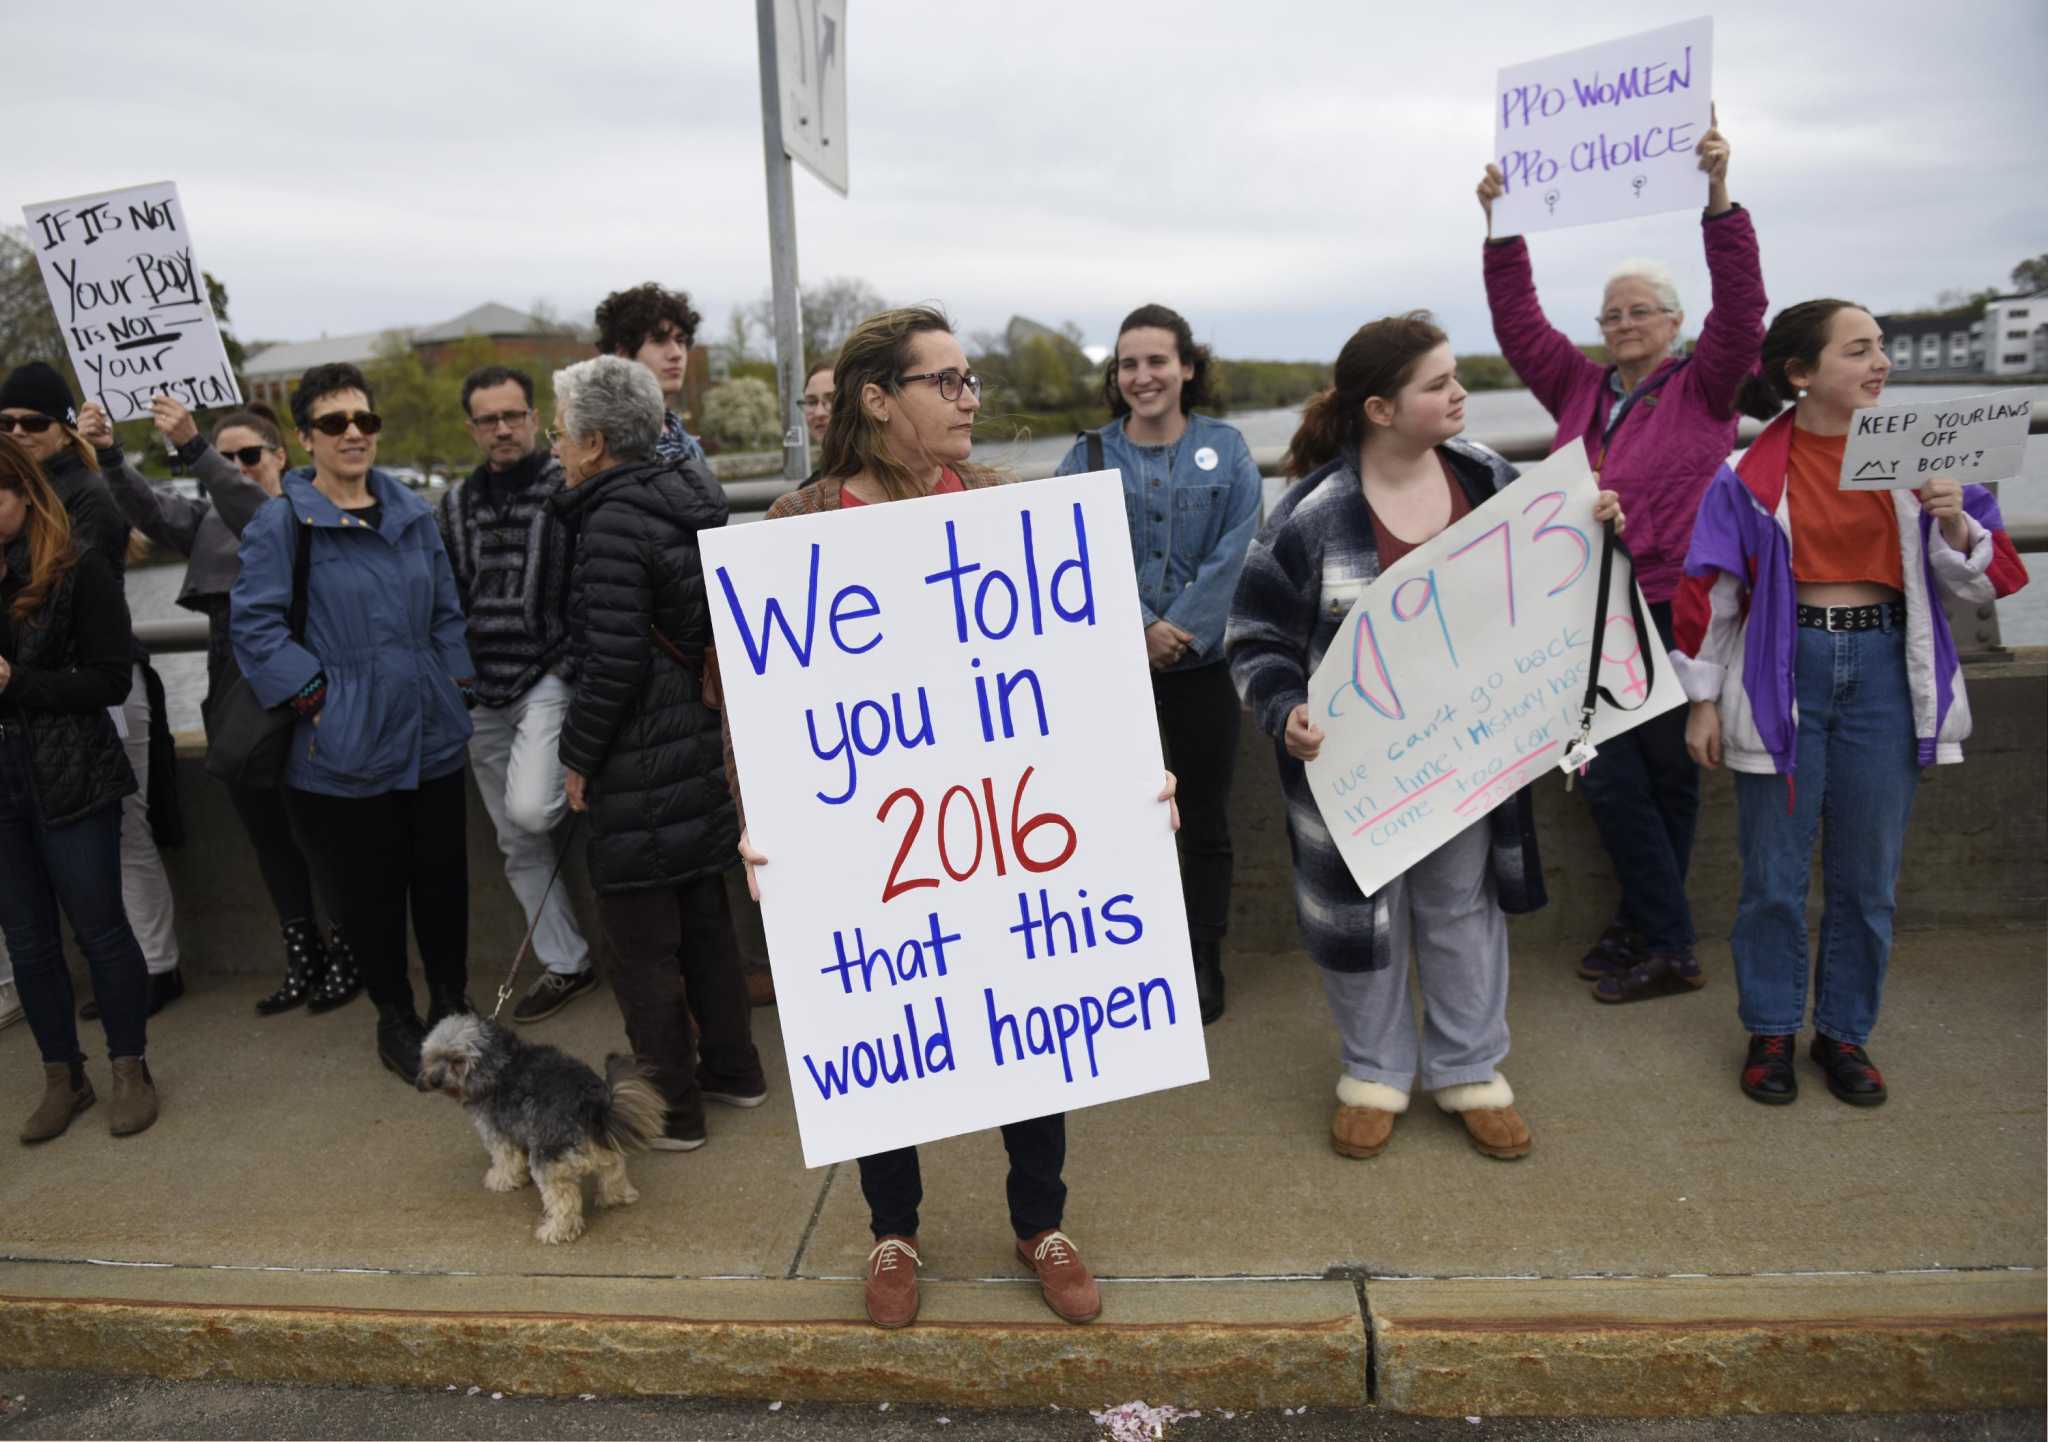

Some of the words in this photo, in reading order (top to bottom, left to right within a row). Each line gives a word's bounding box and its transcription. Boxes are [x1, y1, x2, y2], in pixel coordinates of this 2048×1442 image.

[36, 210, 72, 251] IF
[128, 198, 174, 232] NOT
[107, 315, 162, 343] NOT
[1857, 412, 1918, 436] KEEP
[1935, 407, 1985, 429] YOUR
[1987, 400, 2030, 421] LAWS
[1921, 430, 1959, 448] OFF
[1855, 459, 1901, 477] MY
[716, 542, 884, 676] We
[924, 502, 1097, 644] told
[1328, 490, 1592, 721] 1973
[1470, 671, 1504, 714] go
[1513, 626, 1591, 674] back
[805, 685, 936, 805] you
[970, 657, 1050, 743] in
[1455, 755, 1504, 793] too
[876, 765, 1078, 904] 2016
[820, 911, 962, 994] that
[1009, 888, 1145, 960] this
[803, 995, 957, 1101] would
[983, 976, 1177, 1083] happen
